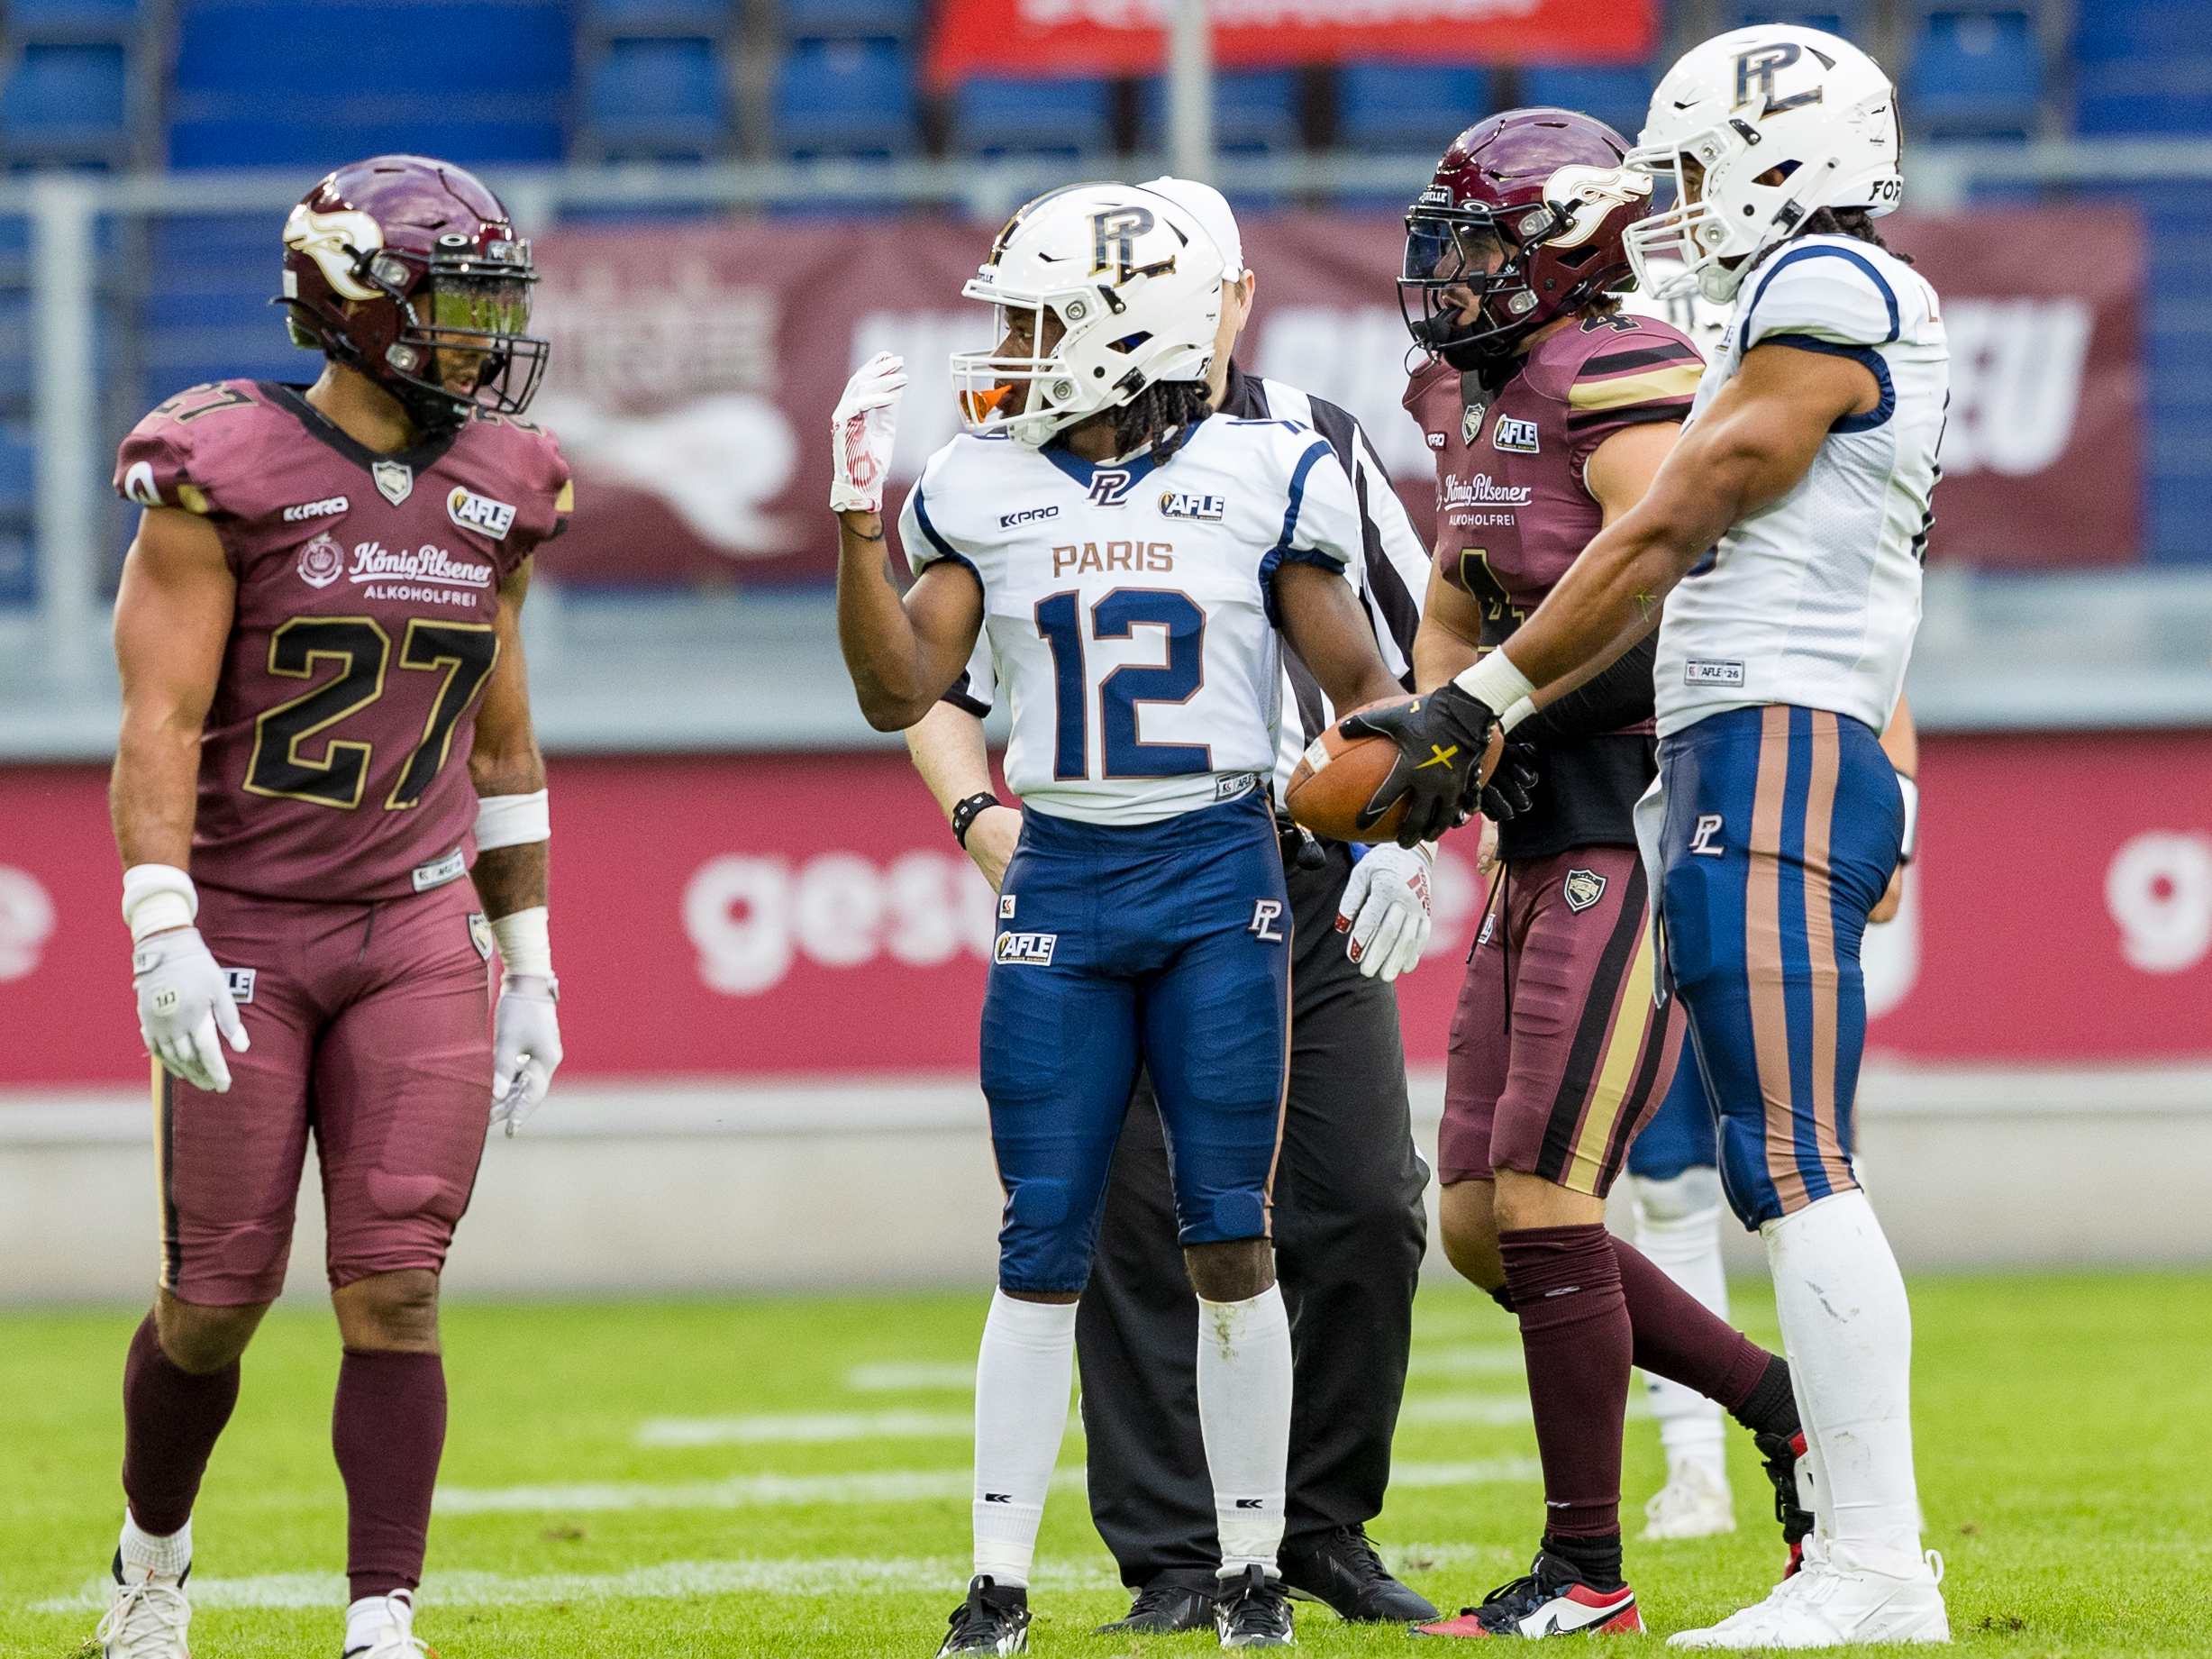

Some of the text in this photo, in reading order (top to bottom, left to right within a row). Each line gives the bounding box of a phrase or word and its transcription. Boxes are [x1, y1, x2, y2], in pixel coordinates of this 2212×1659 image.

[1497, 421, 1535, 445] AFLE
[458, 496, 510, 530] AFLE
[1168, 494, 1224, 517] AFLE
[1449, 514, 1515, 526] ALKOHOLFREI
[1051, 541, 1173, 579] PARIS
[364, 585, 477, 607] ALKOHOLFREI
[1034, 587, 1213, 781] 12
[242, 615, 500, 810] 27
[1001, 936, 1052, 958] AFLE
